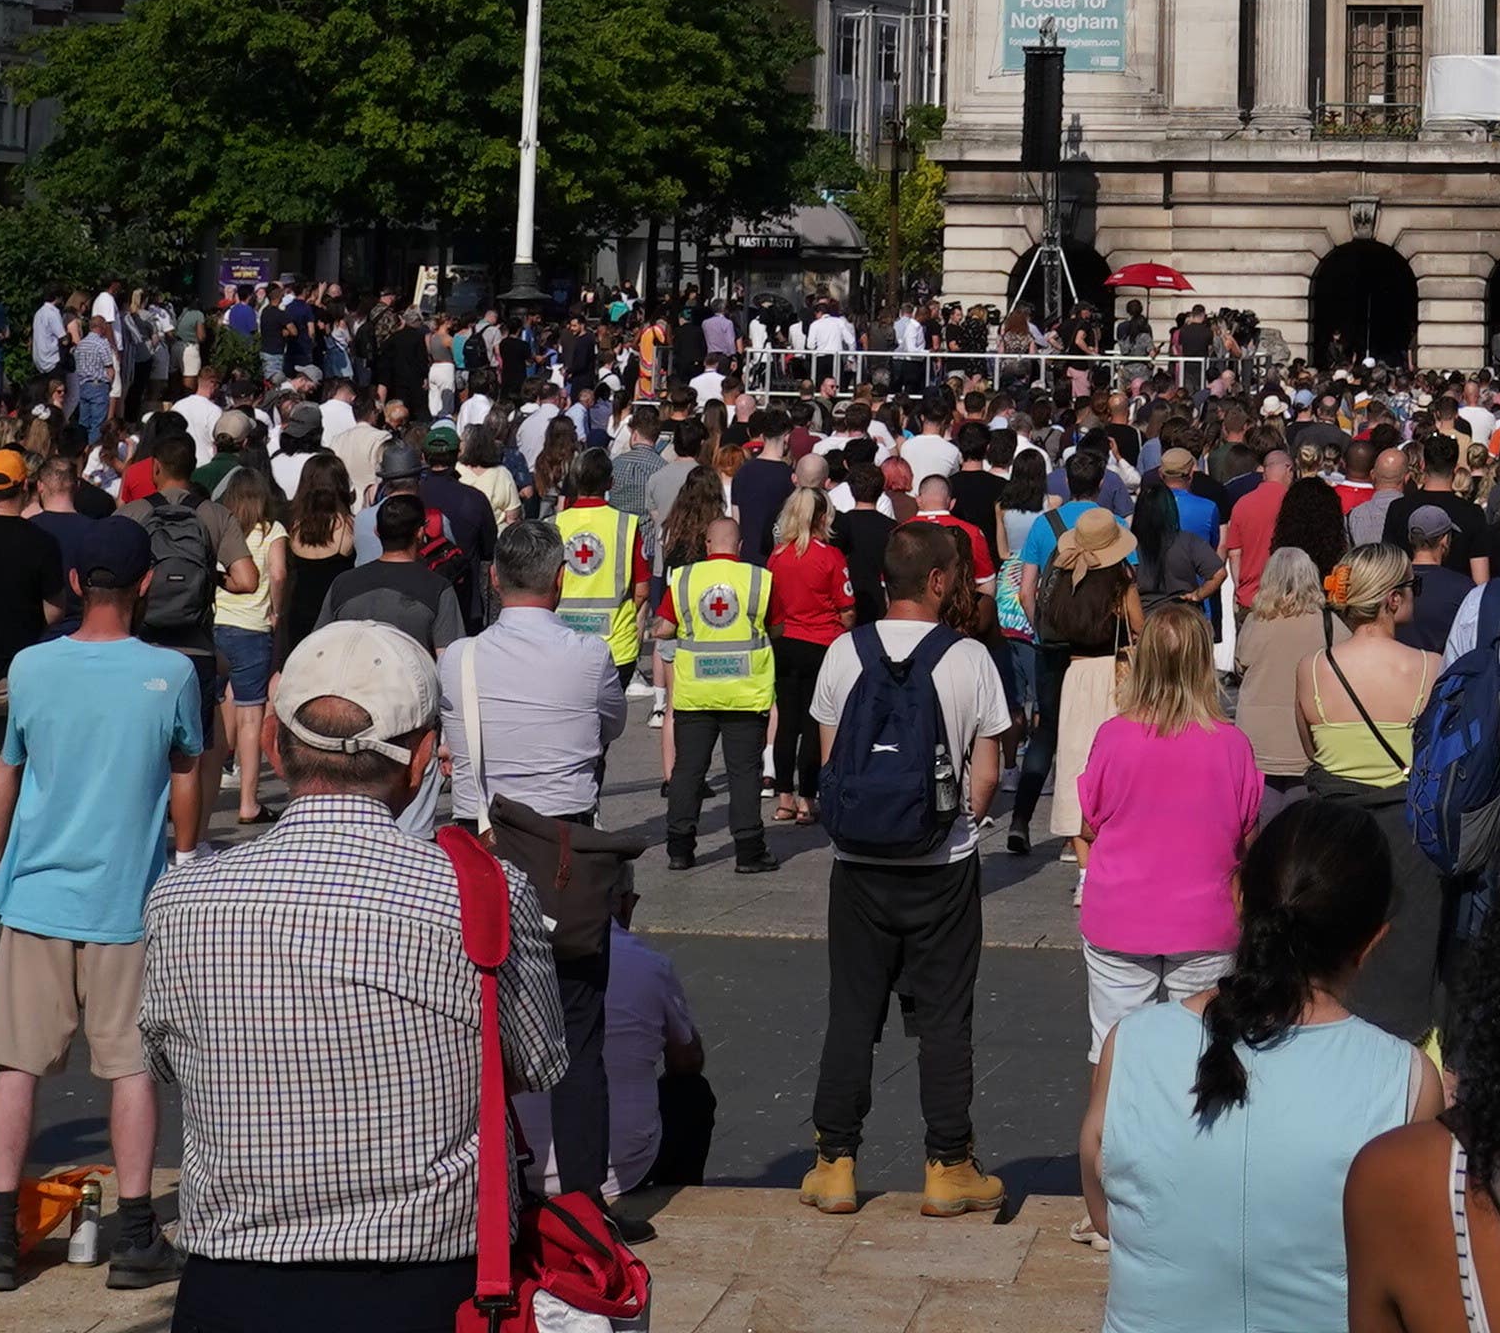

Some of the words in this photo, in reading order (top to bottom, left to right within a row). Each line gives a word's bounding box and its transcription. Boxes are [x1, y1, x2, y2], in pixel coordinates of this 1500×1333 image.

[738, 236, 766, 249] HASTY
[768, 237, 795, 249] TASTY
[699, 656, 744, 667] EMERGENCY
[703, 666, 741, 676] RESPONSE
